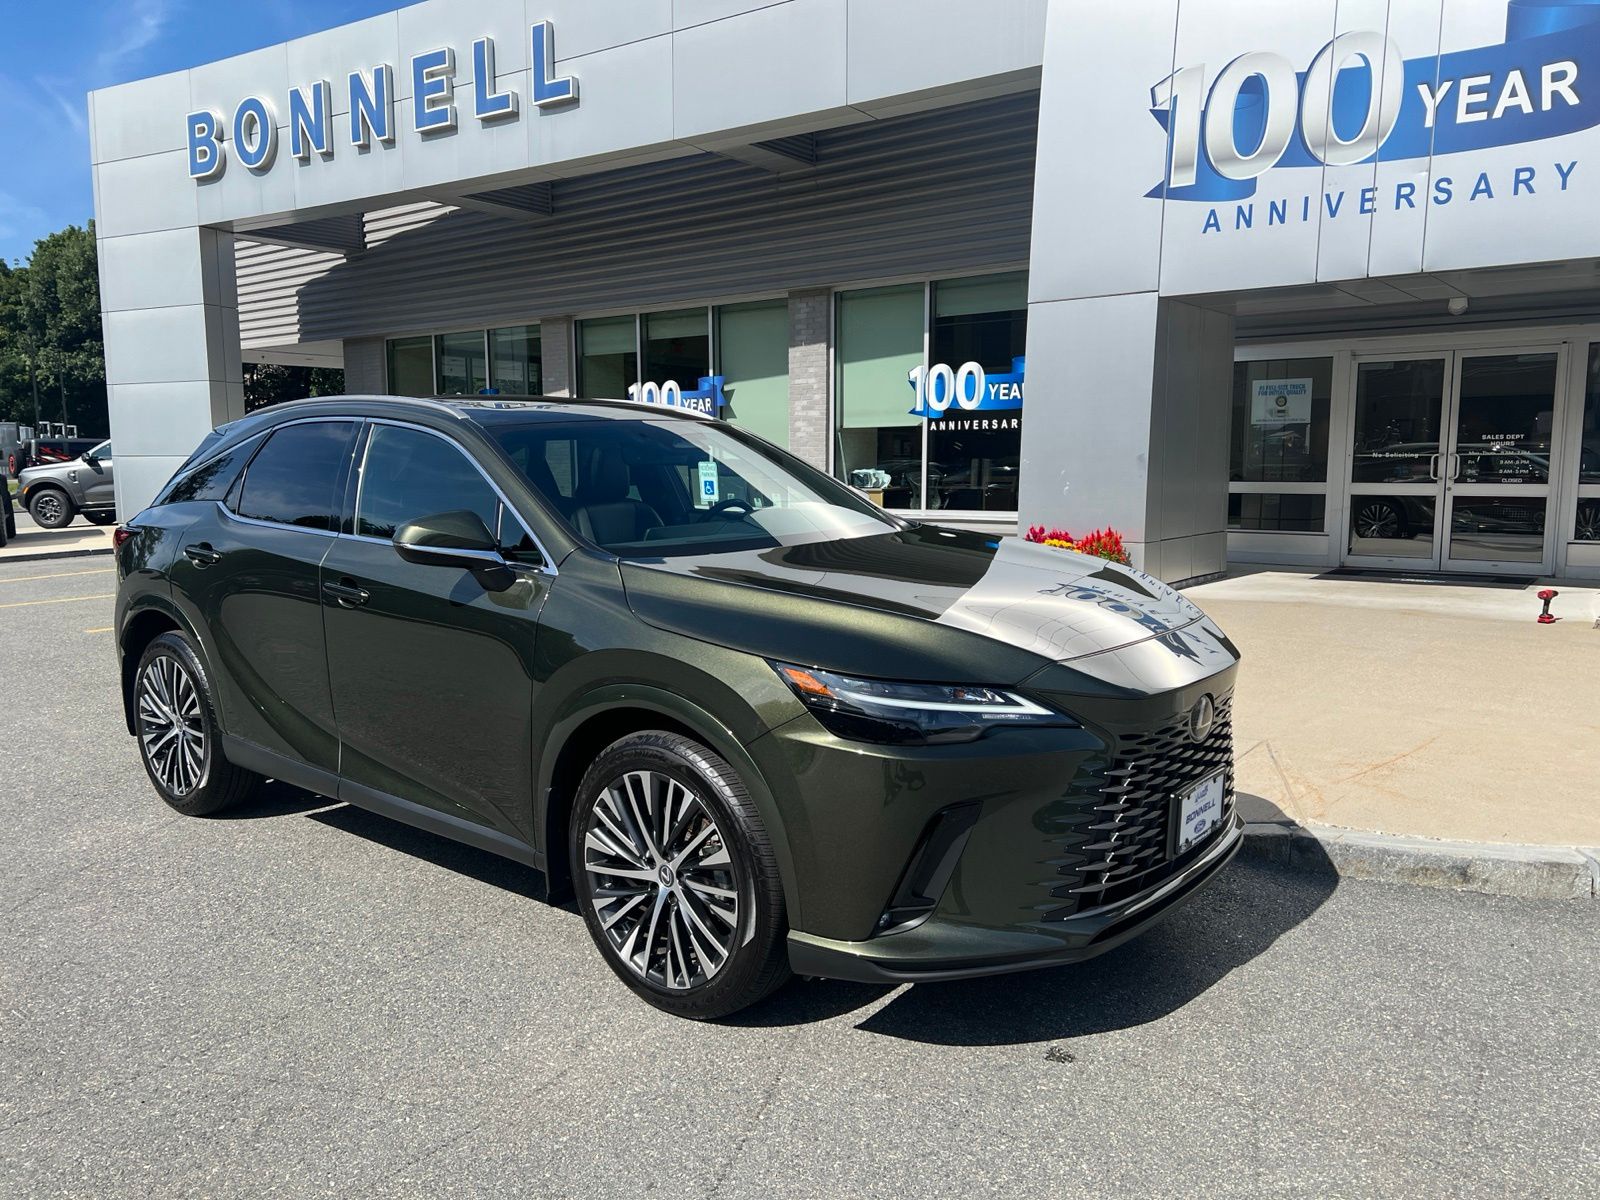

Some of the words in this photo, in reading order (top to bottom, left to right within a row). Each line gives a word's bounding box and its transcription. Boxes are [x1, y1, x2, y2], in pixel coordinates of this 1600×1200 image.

[186, 19, 579, 180] BONNELL
[1151, 30, 1404, 188] 100
[1417, 60, 1580, 128] YEAR
[1202, 160, 1578, 234] ANNIVERSARY
[628, 379, 681, 407] 100
[908, 360, 985, 411] 100
[930, 418, 1022, 431] ANNIVERSAR
[1185, 798, 1216, 825] BONNELL
